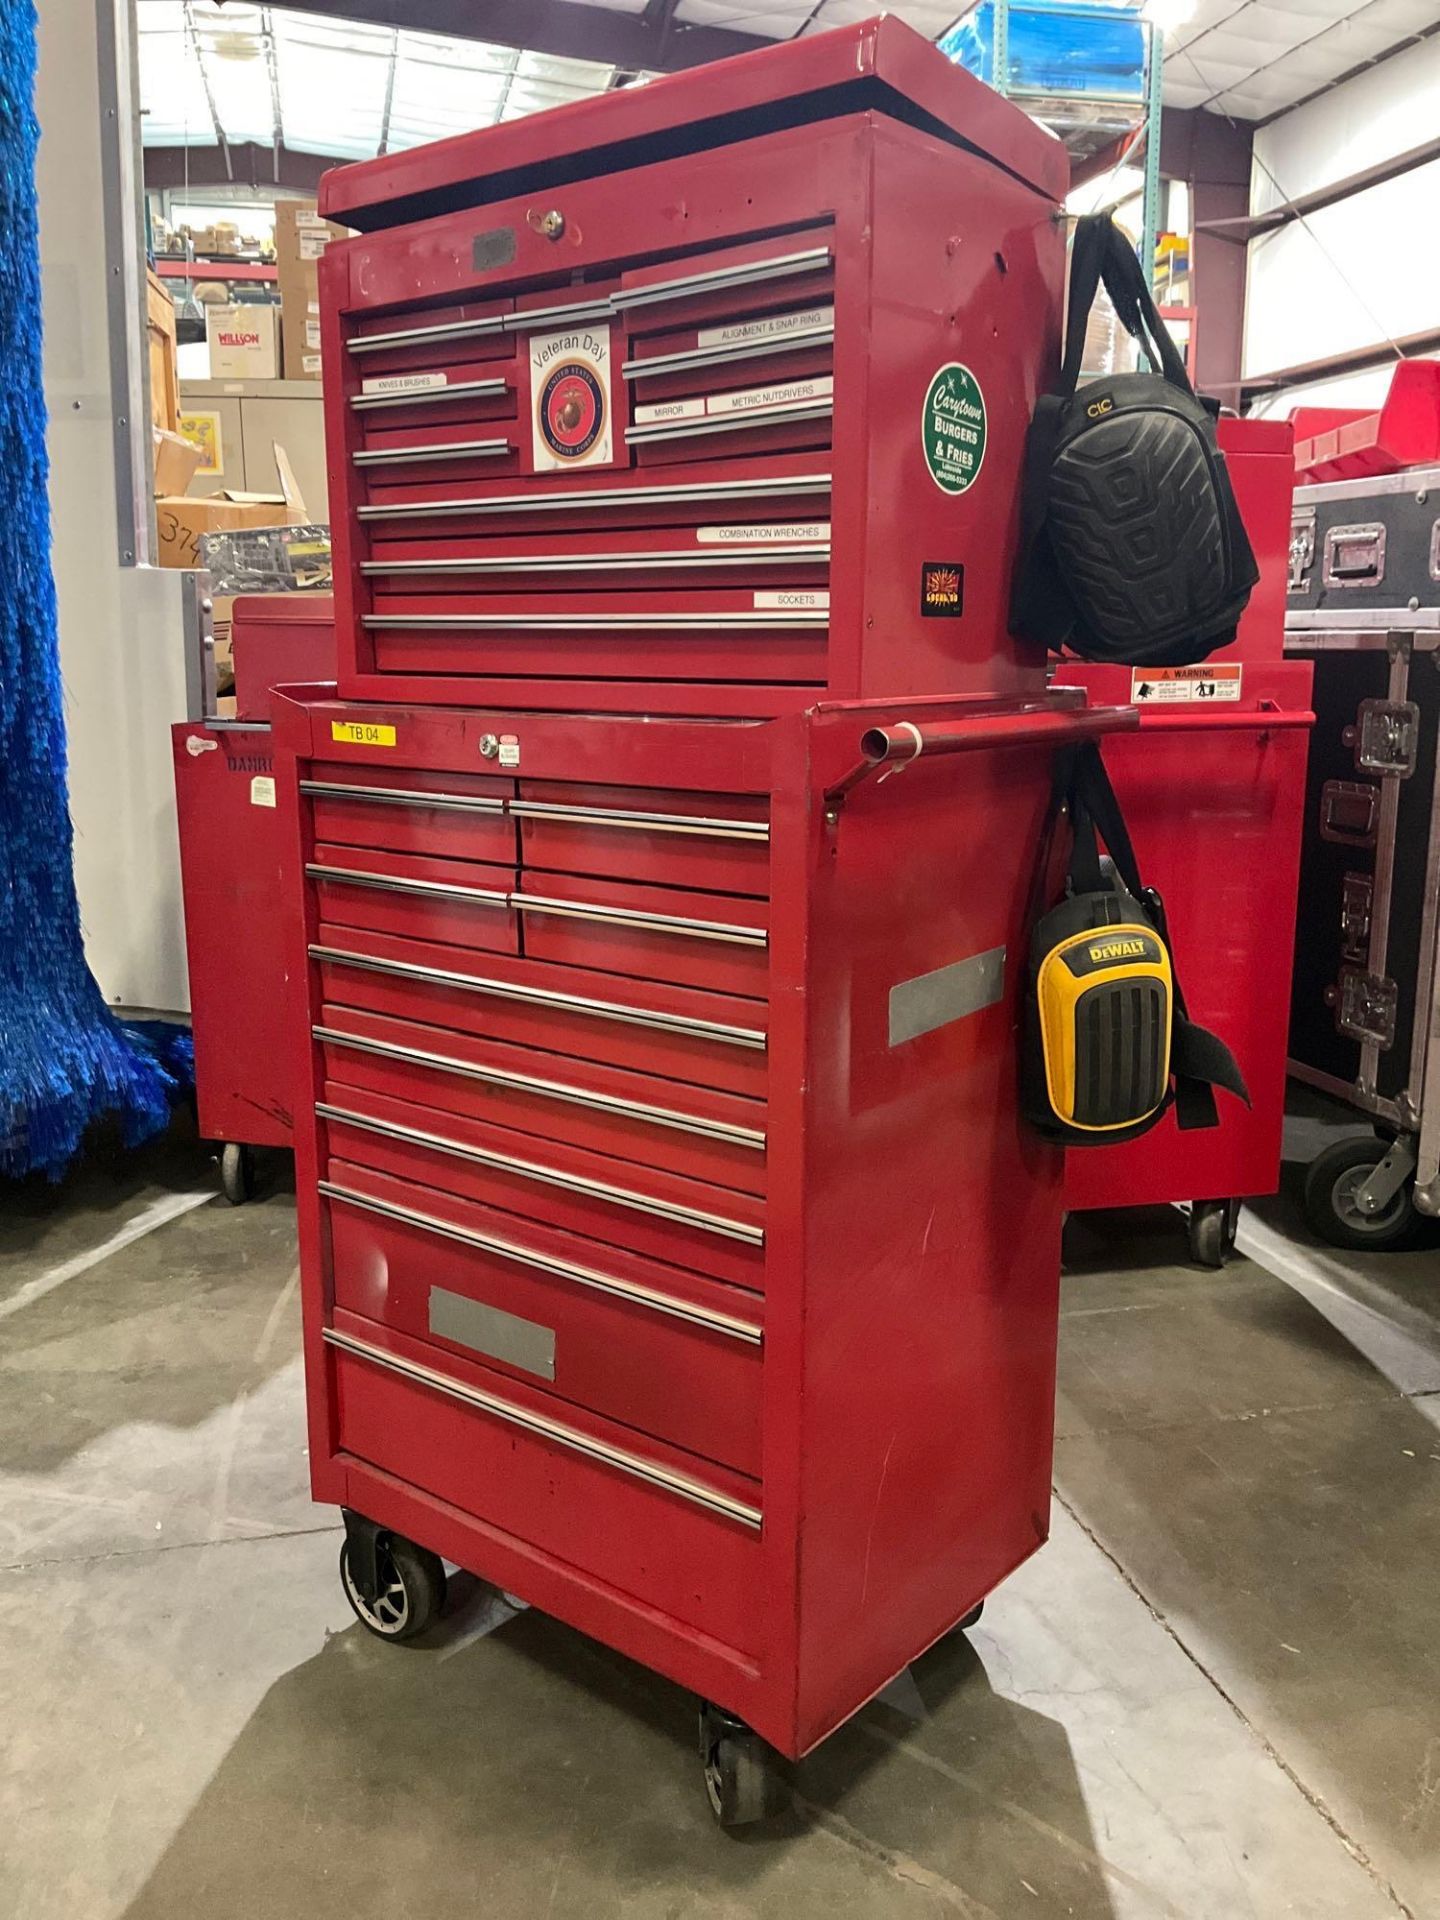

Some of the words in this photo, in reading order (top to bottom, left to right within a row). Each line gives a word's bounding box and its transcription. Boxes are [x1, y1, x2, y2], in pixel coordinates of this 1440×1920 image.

[722, 322, 765, 340] ALIGNMENT
[768, 322, 774, 332] &
[775, 317, 798, 330] SNAP
[799, 313, 822, 325] RING
[218, 333, 260, 346] WILLSON
[533, 335, 579, 369] Veteran
[583, 334, 607, 362] Day
[378, 380, 398, 389] KNIVES
[404, 377, 431, 388] BRUSHES
[547, 368, 569, 391] UNITED
[570, 367, 594, 385] STATES
[731, 393, 762, 407] METRIC
[762, 385, 815, 402] NUTDRIVERS
[933, 384, 982, 421] Carytown
[654, 405, 684, 417] MIRROR
[1087, 398, 1113, 418] CLC
[934, 415, 978, 445] BURGERS
[550, 438, 574, 456] MARINE
[576, 434, 595, 453] CORPS
[935, 440, 944, 457] &
[947, 443, 974, 467] FRIES
[719, 528, 772, 539] COMBINATION
[773, 527, 820, 538] WRENCHES
[777, 595, 815, 605] SOCKETS
[1174, 669, 1214, 678] WARNING
[348, 725, 363, 740] TB
[366, 727, 379, 742] 04
